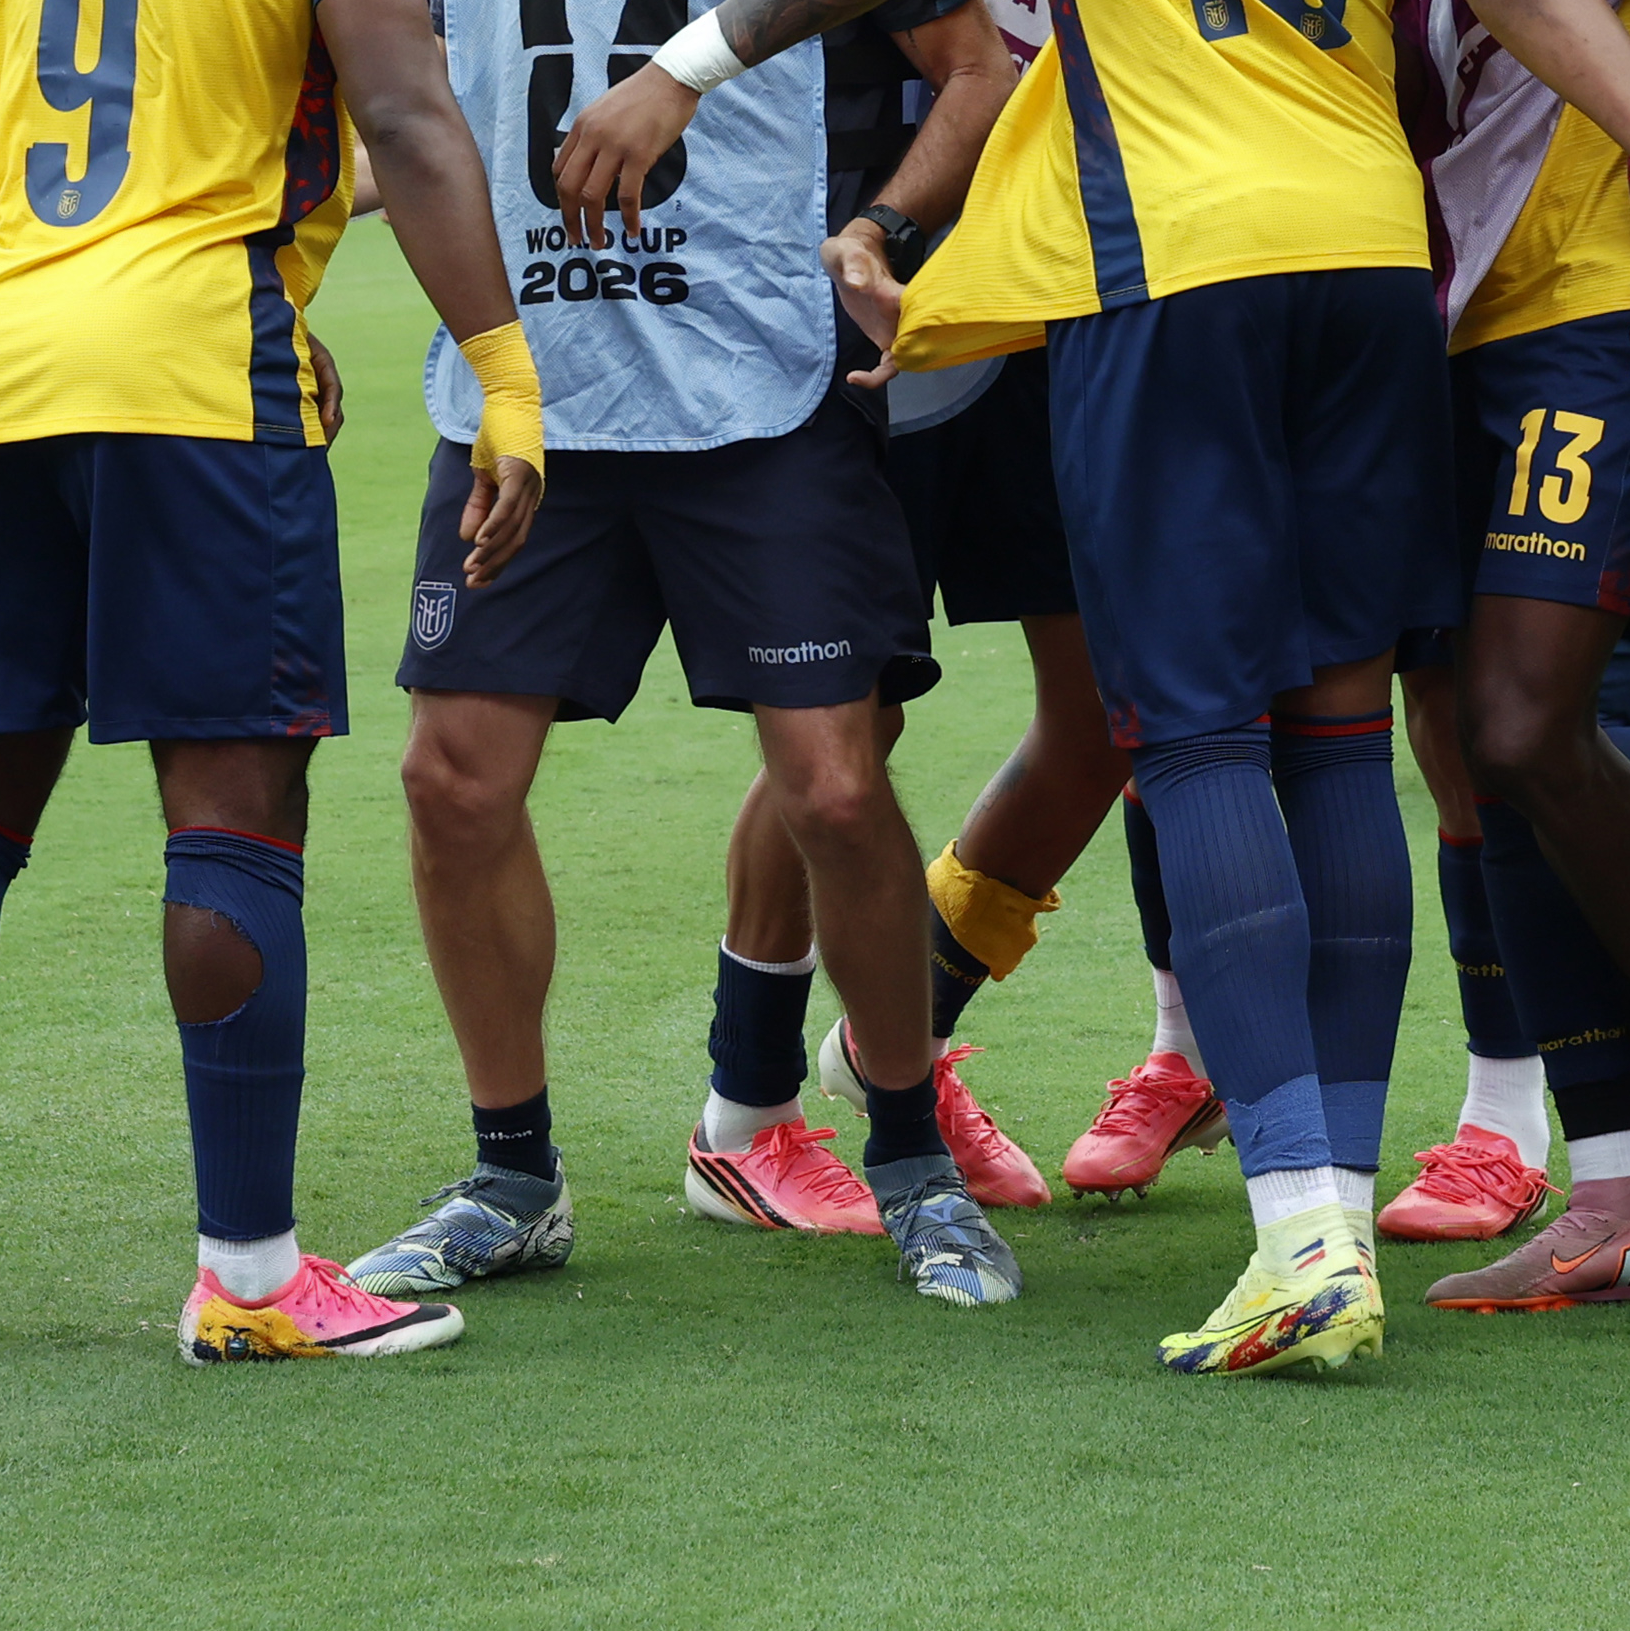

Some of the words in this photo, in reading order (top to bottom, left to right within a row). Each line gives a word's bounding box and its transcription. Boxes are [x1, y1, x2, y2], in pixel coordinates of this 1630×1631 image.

[621, 227, 688, 254] CUP
[520, 257, 690, 306] 2026
[1507, 406, 1605, 525] 13
[1483, 529, 1586, 562] marathon
[748, 638, 852, 667] marathon
